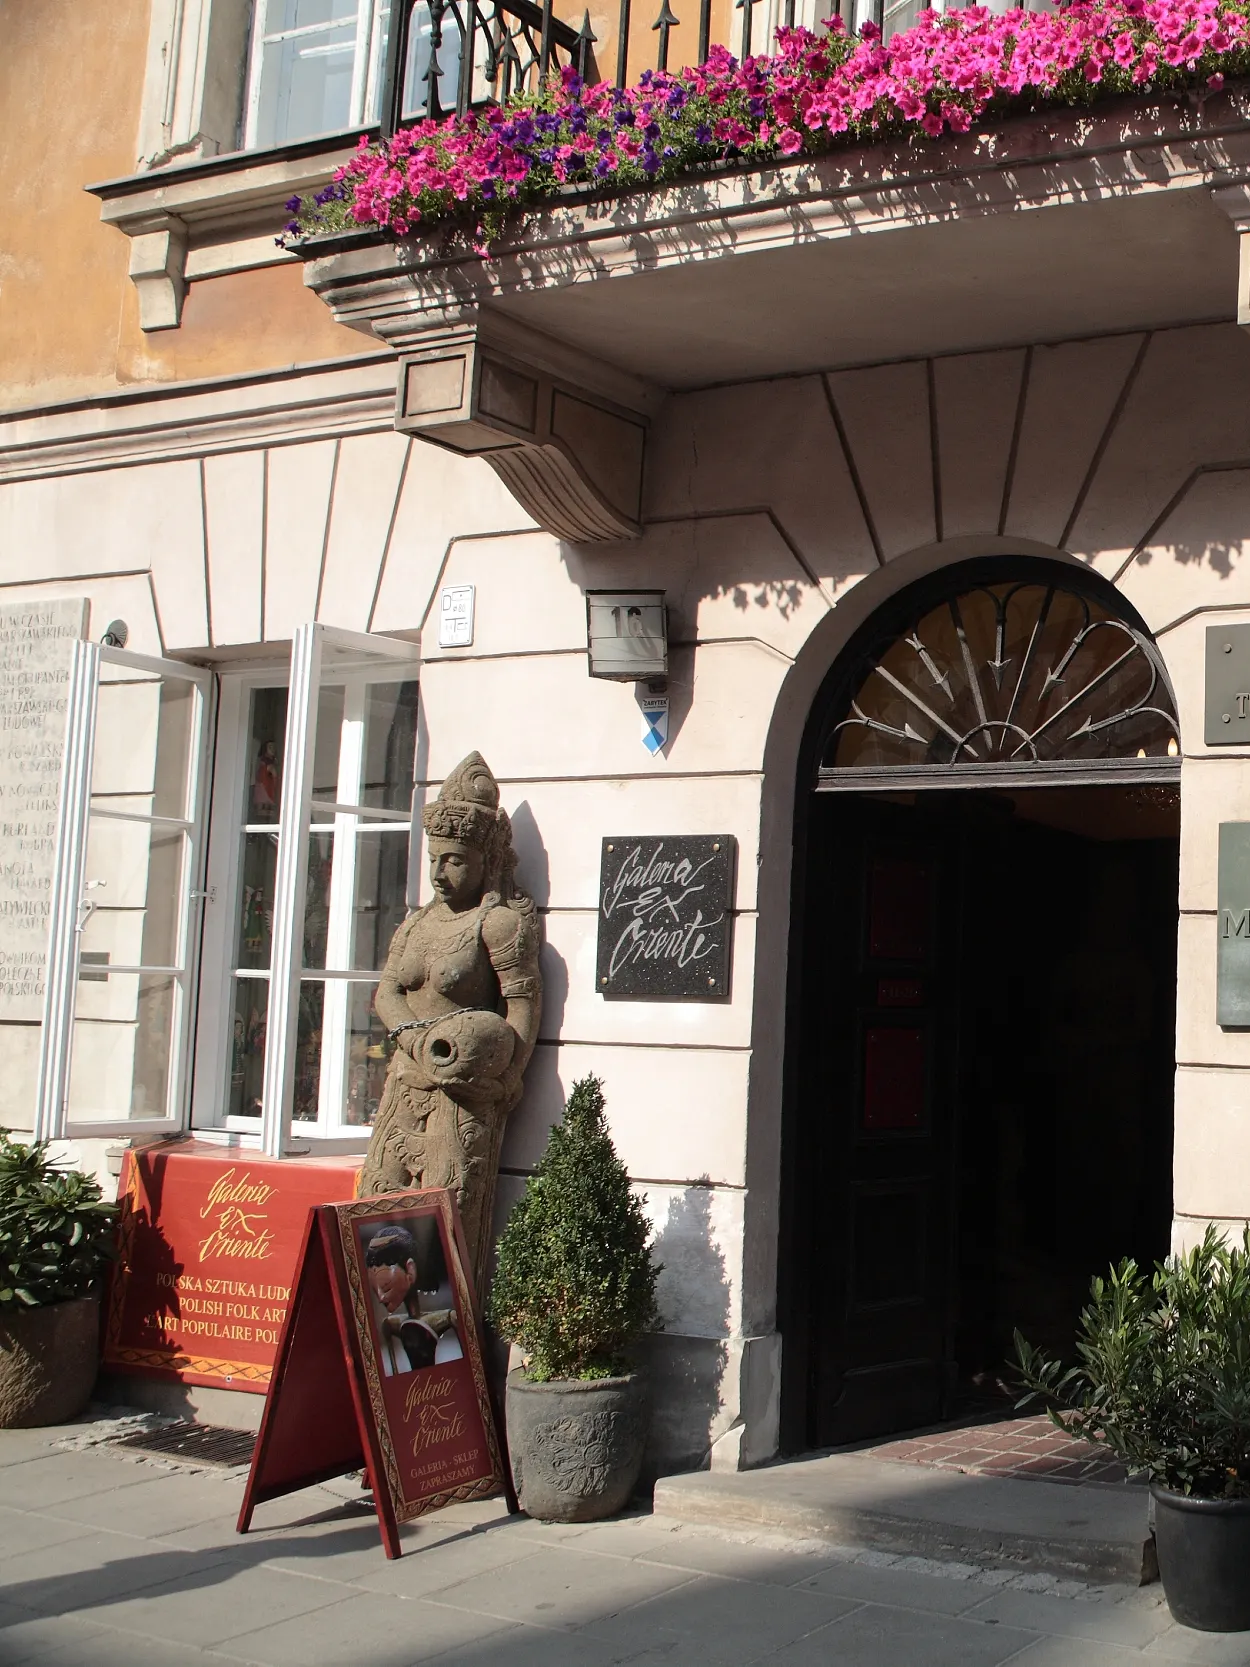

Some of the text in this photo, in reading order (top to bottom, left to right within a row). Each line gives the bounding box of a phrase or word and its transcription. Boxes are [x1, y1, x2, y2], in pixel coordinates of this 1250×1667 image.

[200, 1167, 280, 1218] Galeria
[199, 1228, 275, 1262] Oriente
[156, 1272, 202, 1292] POLSKA
[205, 1278, 257, 1298] SZTUKA
[179, 1297, 223, 1316] POLISH
[226, 1303, 261, 1320] FOLK
[181, 1319, 252, 1341] POPULAIRE
[403, 1374, 457, 1423] Galeria
[410, 1411, 467, 1457] Oriente
[410, 1459, 448, 1479] GALERIA
[452, 1449, 479, 1466] SKLEP
[419, 1464, 475, 1491] ZAPRASZAMY
